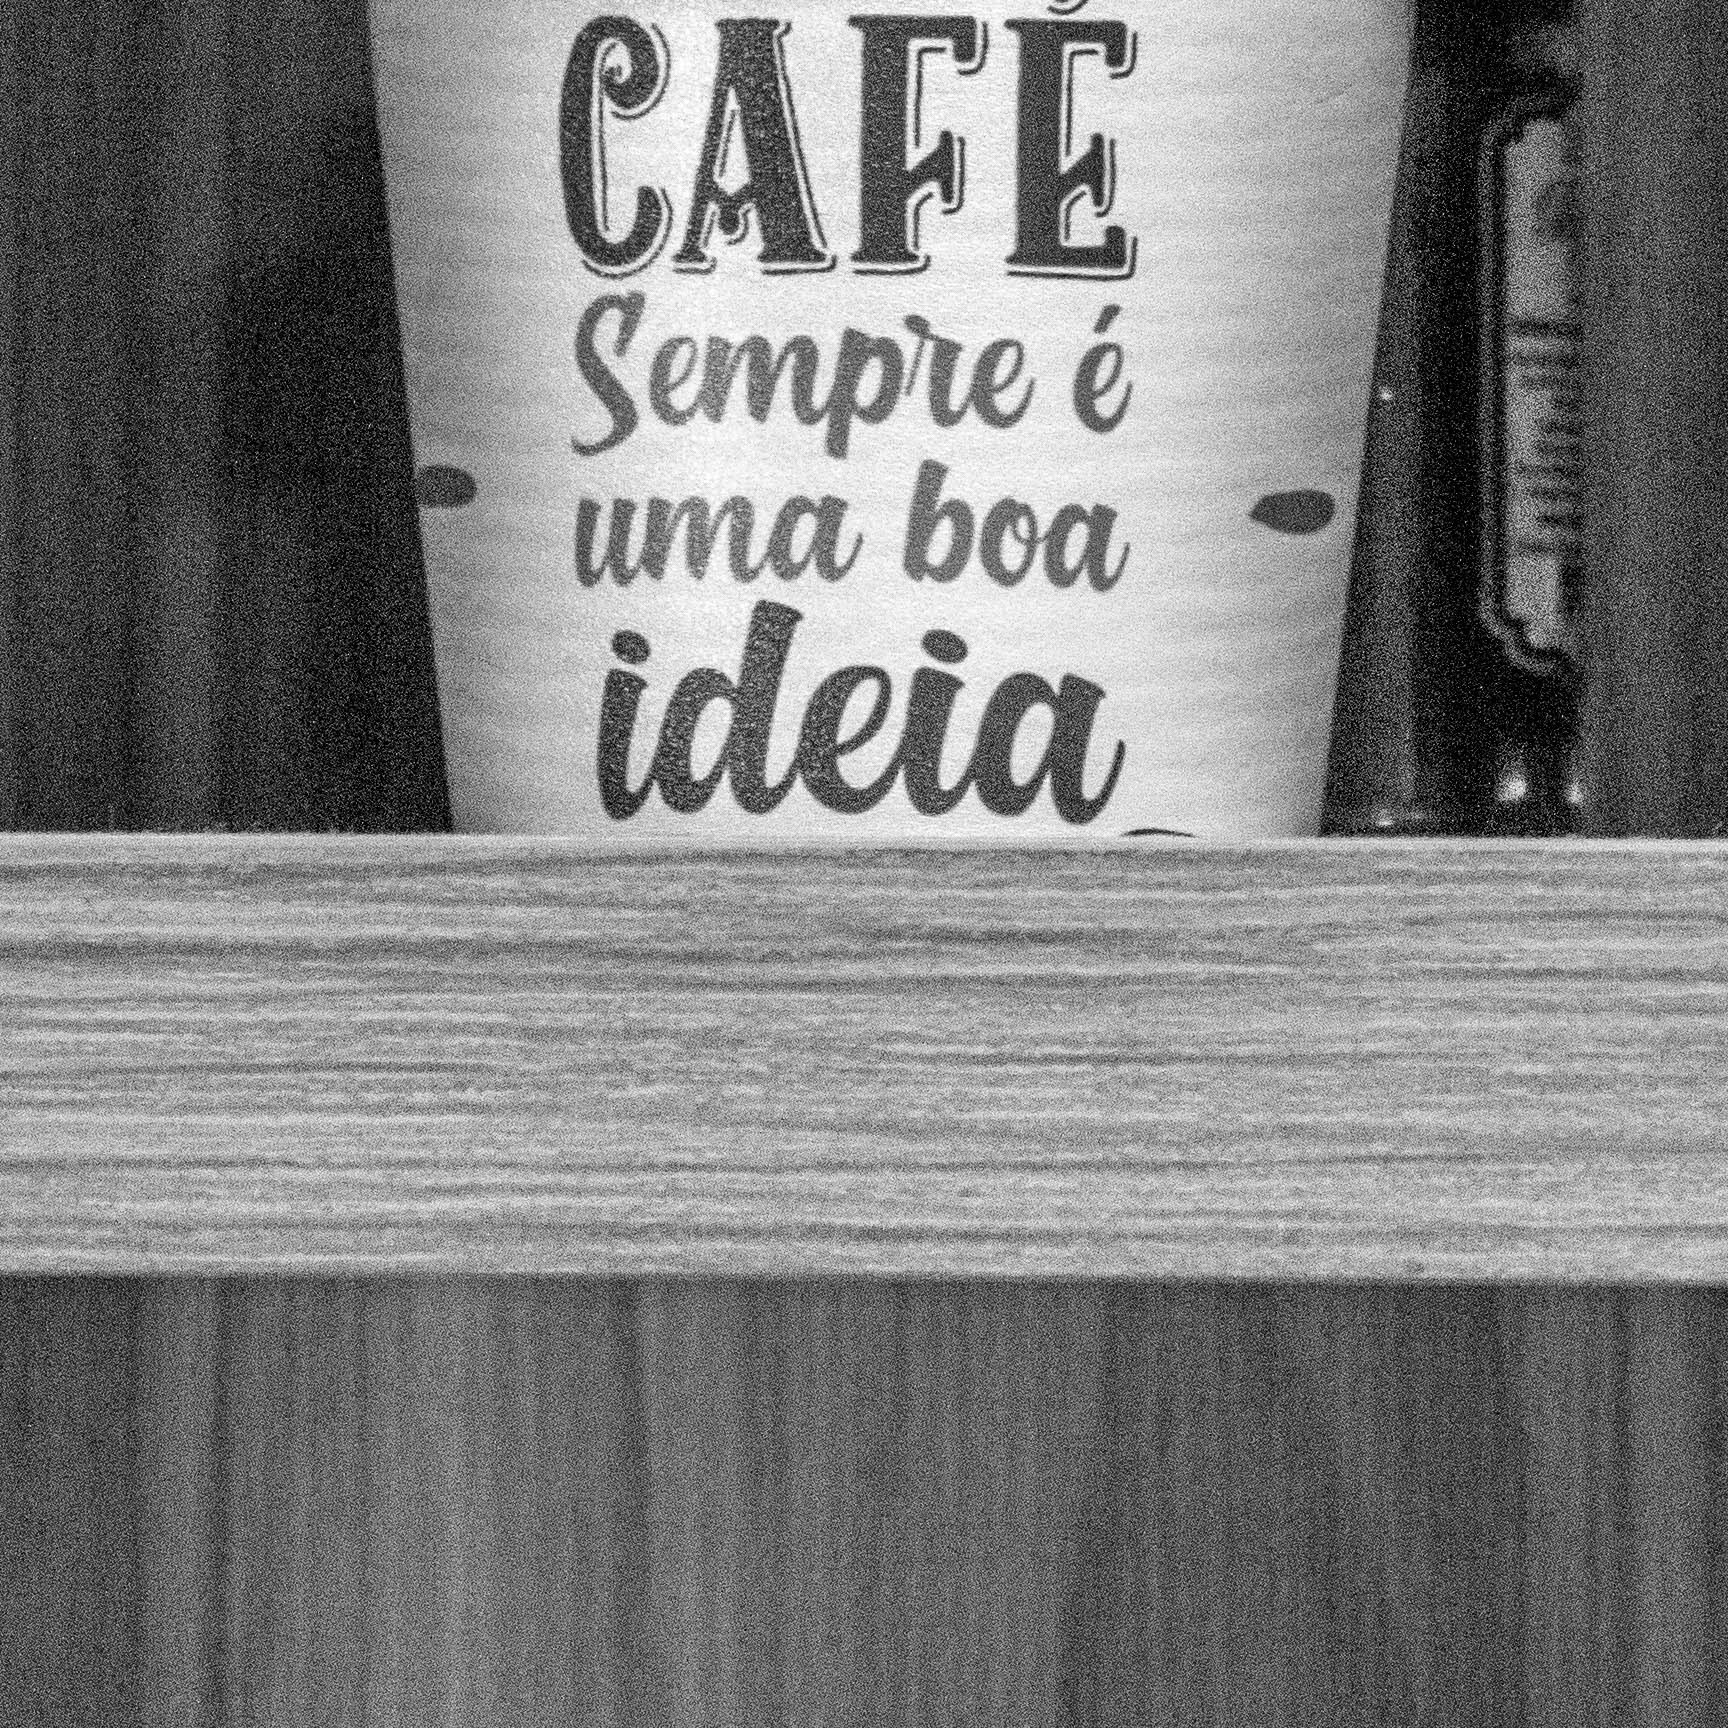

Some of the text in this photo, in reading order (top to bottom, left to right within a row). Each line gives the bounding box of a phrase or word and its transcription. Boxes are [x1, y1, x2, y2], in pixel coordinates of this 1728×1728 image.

[570, 290, 1133, 460] Sempre é
[572, 460, 1131, 593] uma boa
[595, 599, 1127, 825] ideia
